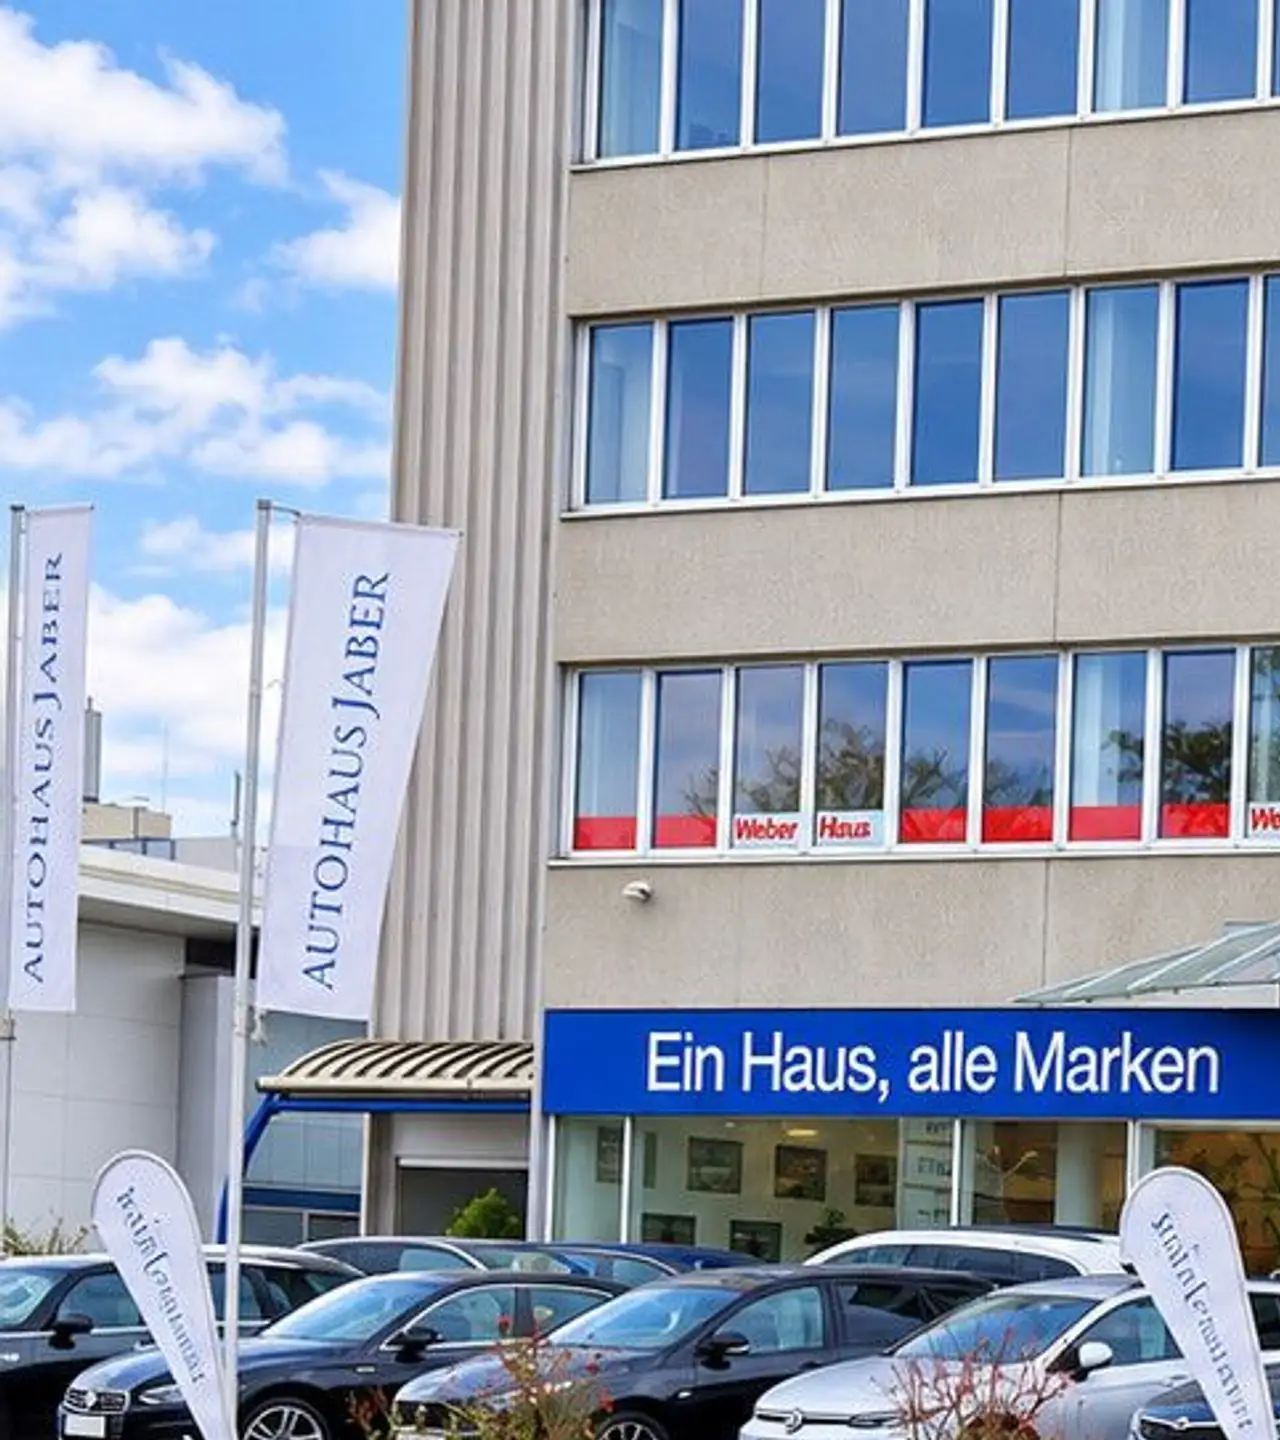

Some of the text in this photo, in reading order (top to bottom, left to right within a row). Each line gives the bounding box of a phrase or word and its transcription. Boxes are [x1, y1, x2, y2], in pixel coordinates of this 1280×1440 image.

[23, 553, 63, 983] AUTOHAUS JABER
[302, 573, 391, 990] AUTOHAUS JABER
[736, 815, 872, 840] Weber Haus
[647, 1030, 1218, 1103] Ein Haus, alle Marken
